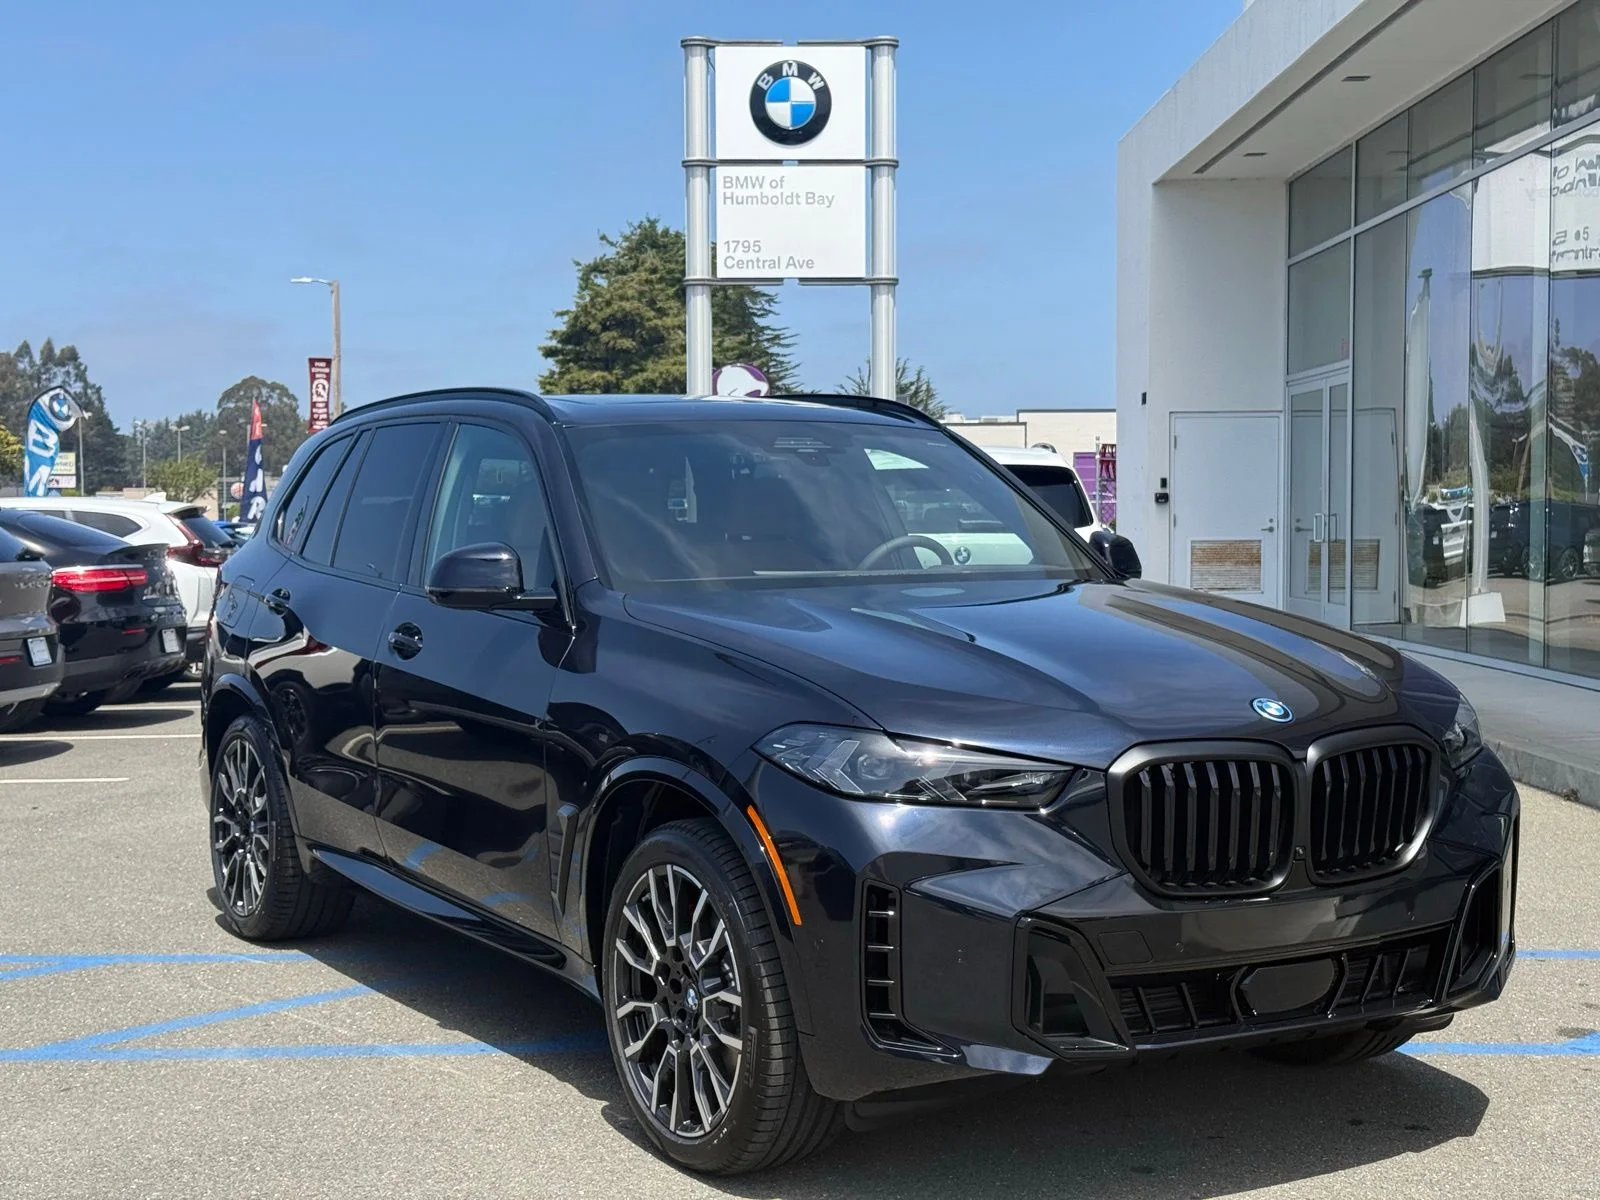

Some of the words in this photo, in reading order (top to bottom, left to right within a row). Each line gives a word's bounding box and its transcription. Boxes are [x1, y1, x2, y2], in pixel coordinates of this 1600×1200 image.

[757, 61, 825, 91] BMW
[723, 175, 766, 189] BMW
[769, 175, 784, 189] of
[723, 191, 801, 205] Humboldt
[805, 191, 835, 208] Bay
[723, 240, 762, 253] 1795
[723, 255, 781, 269] Central
[785, 255, 815, 269] Ave
